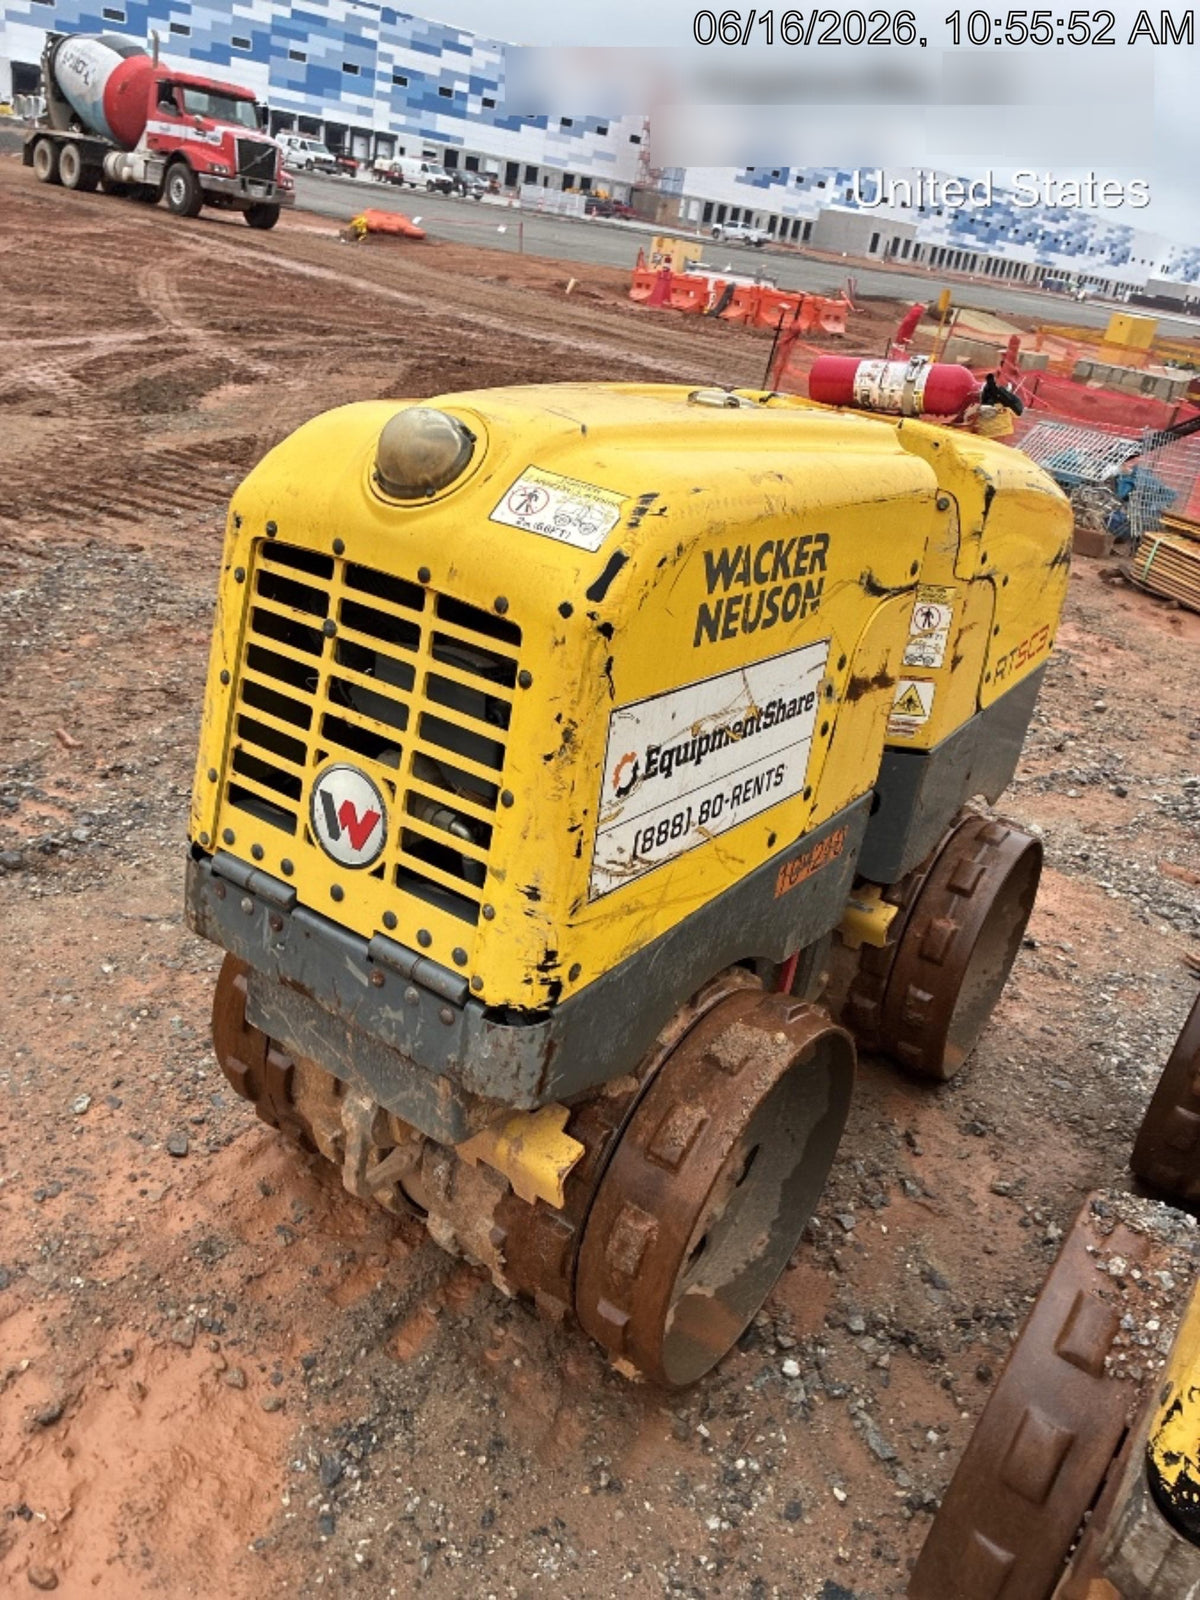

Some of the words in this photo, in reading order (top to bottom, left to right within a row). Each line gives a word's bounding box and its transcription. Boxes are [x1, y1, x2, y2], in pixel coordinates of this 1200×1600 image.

[704, 532, 830, 595] WACKER
[693, 577, 825, 648] NEUSON
[644, 690, 816, 779] EquipmentShare
[632, 807, 693, 859] (888)
[698, 764, 785, 827] 80-RENTS
